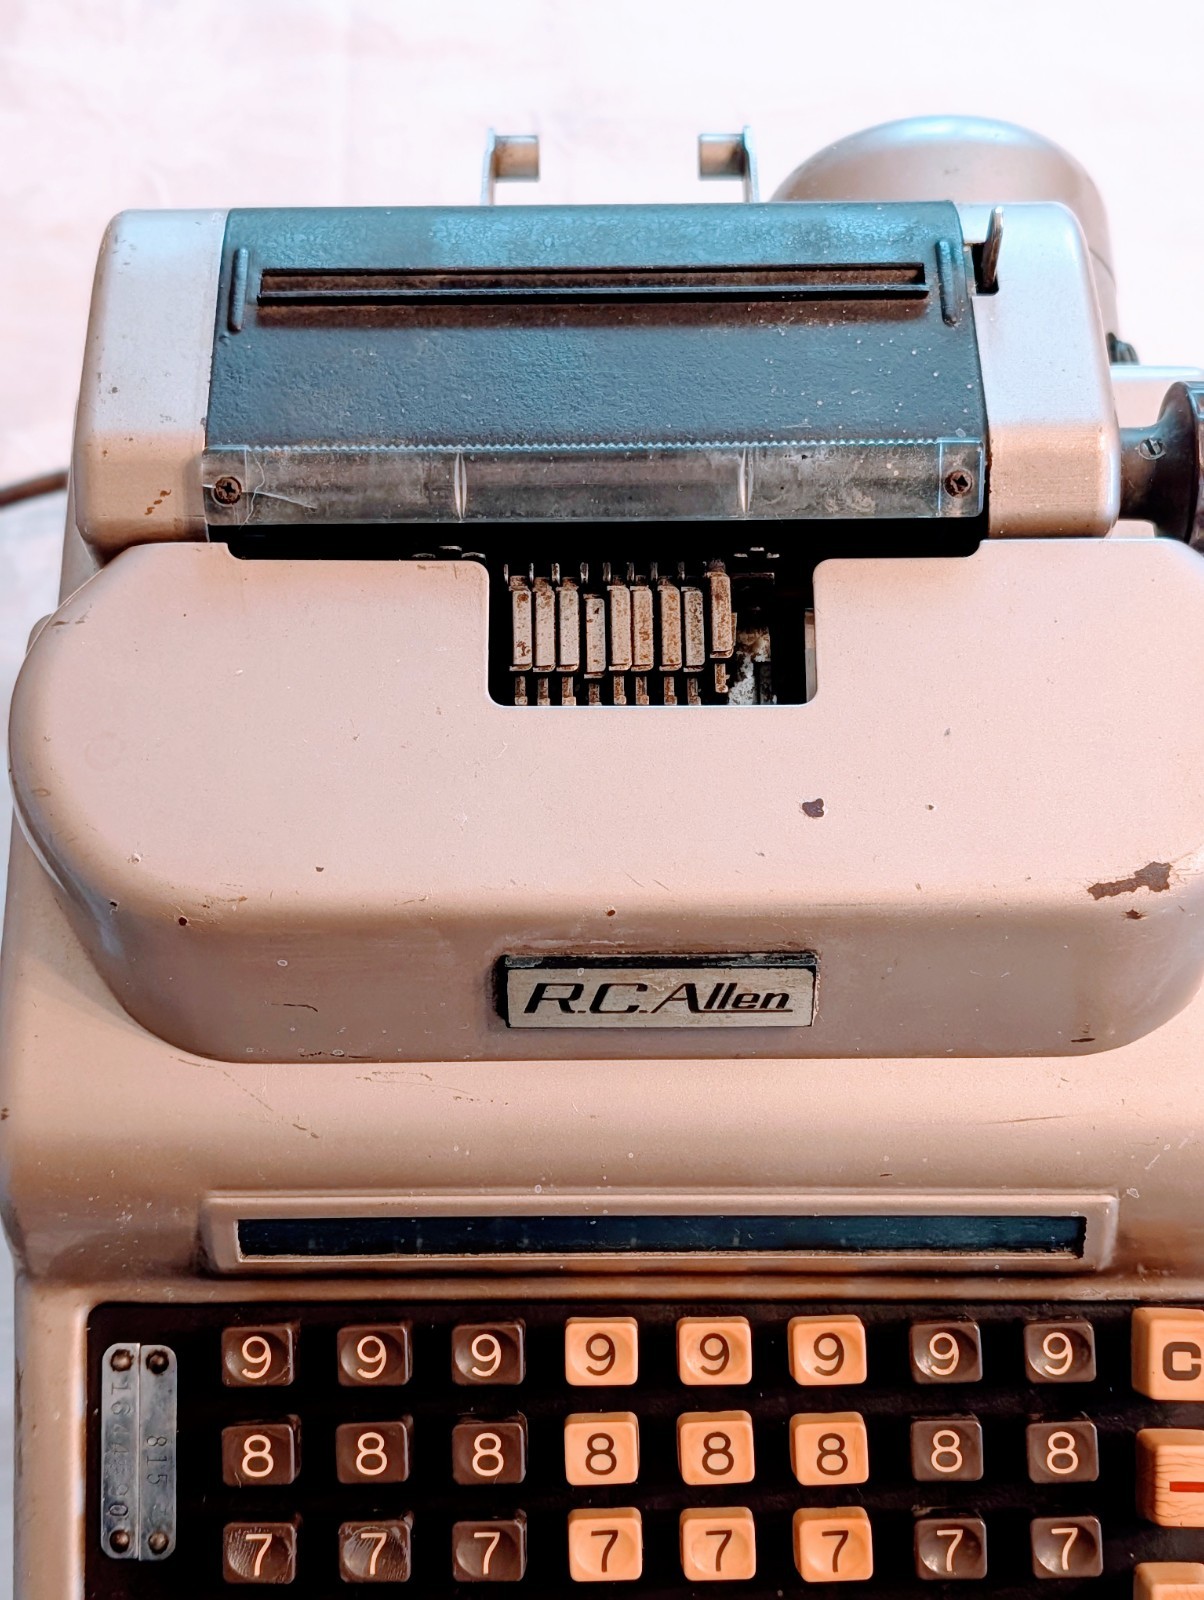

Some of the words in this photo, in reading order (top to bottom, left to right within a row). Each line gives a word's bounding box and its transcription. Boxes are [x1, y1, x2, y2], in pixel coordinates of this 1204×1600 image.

[242, 1335, 272, 1379] 9
[357, 1335, 387, 1379] 9
[472, 1334, 502, 1377] 9
[586, 1333, 616, 1376] 9
[700, 1333, 730, 1376] 9
[814, 1332, 845, 1376] 9
[928, 1333, 959, 1377] 9
[1042, 1332, 1073, 1376] 9
[1163, 1342, 1202, 1381] C
[242, 1434, 274, 1478] 8
[356, 1432, 388, 1476] 8
[472, 1433, 504, 1477] 8
[586, 1433, 618, 1476] 8
[702, 1432, 735, 1476] 8
[817, 1433, 849, 1476] 8
[931, 1430, 963, 1473] 8
[1047, 1431, 1079, 1475] 8
[246, 1533, 273, 1578] 7
[361, 1532, 388, 1577] 7
[473, 1532, 501, 1577] 7
[591, 1530, 619, 1573] 7
[706, 1530, 733, 1573] 7
[822, 1530, 849, 1573] 7
[937, 1530, 964, 1573] 7
[1051, 1528, 1079, 1572] 7
